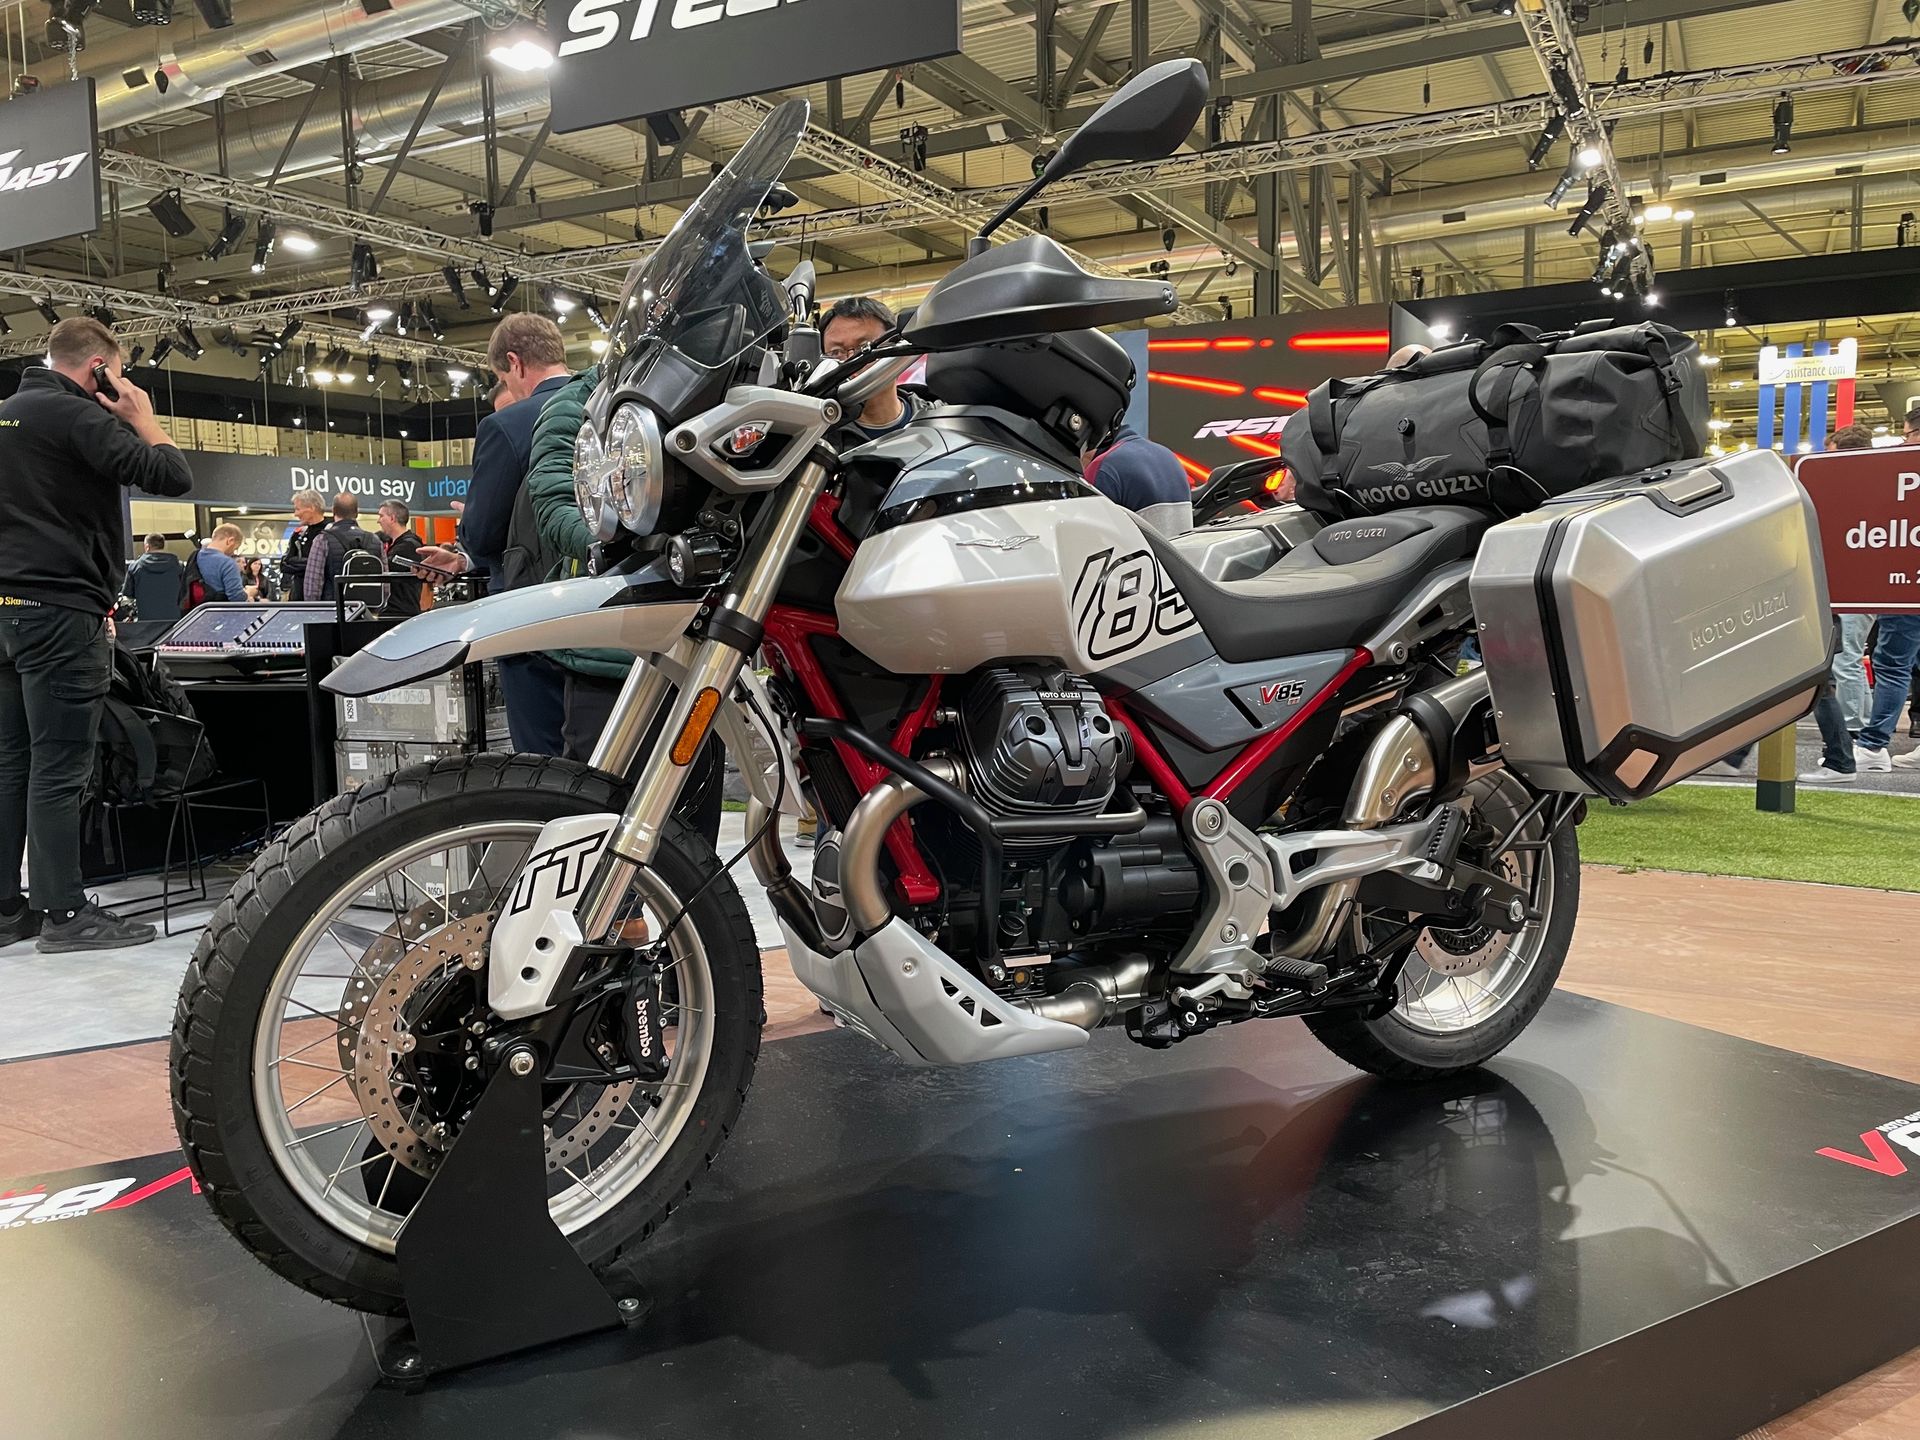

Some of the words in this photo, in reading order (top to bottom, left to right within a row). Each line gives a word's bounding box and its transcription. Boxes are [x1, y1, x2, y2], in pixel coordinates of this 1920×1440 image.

[291, 467, 329, 492] Did
[335, 476, 374, 496] you
[380, 479, 415, 503] say
[1356, 483, 1411, 504] MOTO
[1415, 475, 1485, 498] GUZZI
[1328, 530, 1352, 543] MOTO
[1356, 527, 1387, 538] GUZZI
[1689, 617, 1736, 651] MOTO
[1741, 591, 1789, 626] GUZZI
[1261, 680, 1306, 705] V85
[510, 829, 609, 916] TT
[636, 998, 653, 1057] brembo
[31, 1208, 89, 1225] MOTO
